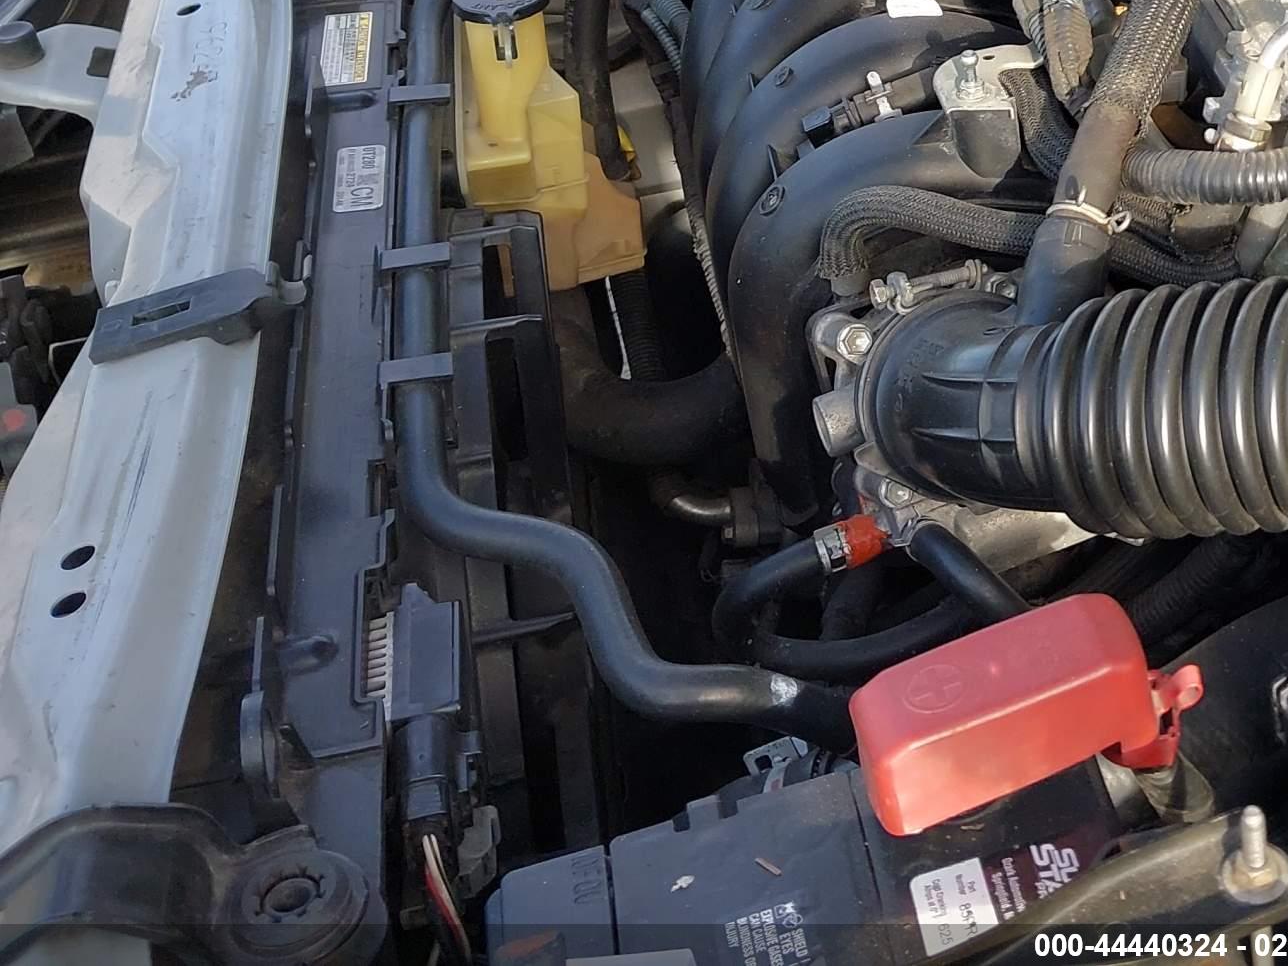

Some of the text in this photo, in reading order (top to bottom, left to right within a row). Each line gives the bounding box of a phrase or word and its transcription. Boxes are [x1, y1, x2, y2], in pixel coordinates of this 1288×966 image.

[351, 186, 374, 207] CM
[967, 880, 977, 893] Part
[1007, 876, 1026, 912] Automotiv
[724, 922, 739, 948] INJURY
[736, 917, 755, 957] BLINDNESS
[748, 913, 765, 952] CAN CAUSE
[760, 909, 778, 945] EXPLOSIVE
[937, 922, 954, 947] 625
[778, 933, 793, 954] EYES
[791, 928, 807, 957] SHIELD
